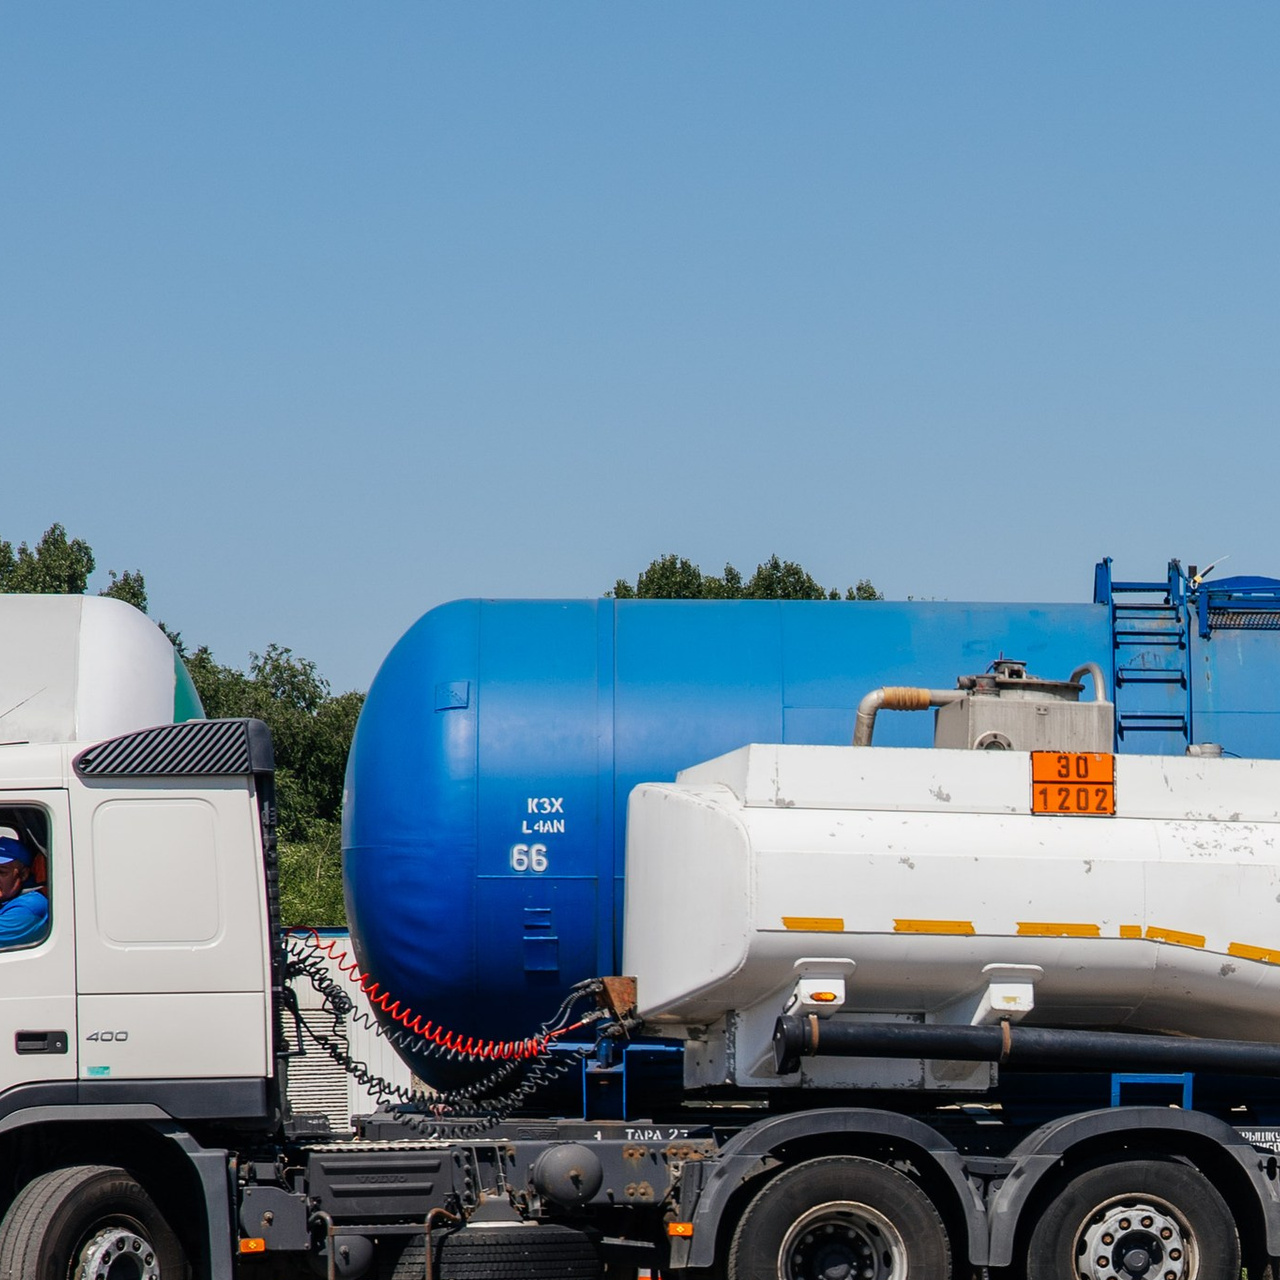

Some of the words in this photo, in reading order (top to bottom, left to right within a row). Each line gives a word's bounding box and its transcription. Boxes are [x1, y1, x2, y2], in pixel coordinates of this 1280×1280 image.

[1057, 755, 1089, 778] 30
[1039, 787, 1108, 811] 1202
[511, 844, 548, 872] 66
[86, 1031, 128, 1042] 400
[625, 1129, 662, 1140] ТАРА
